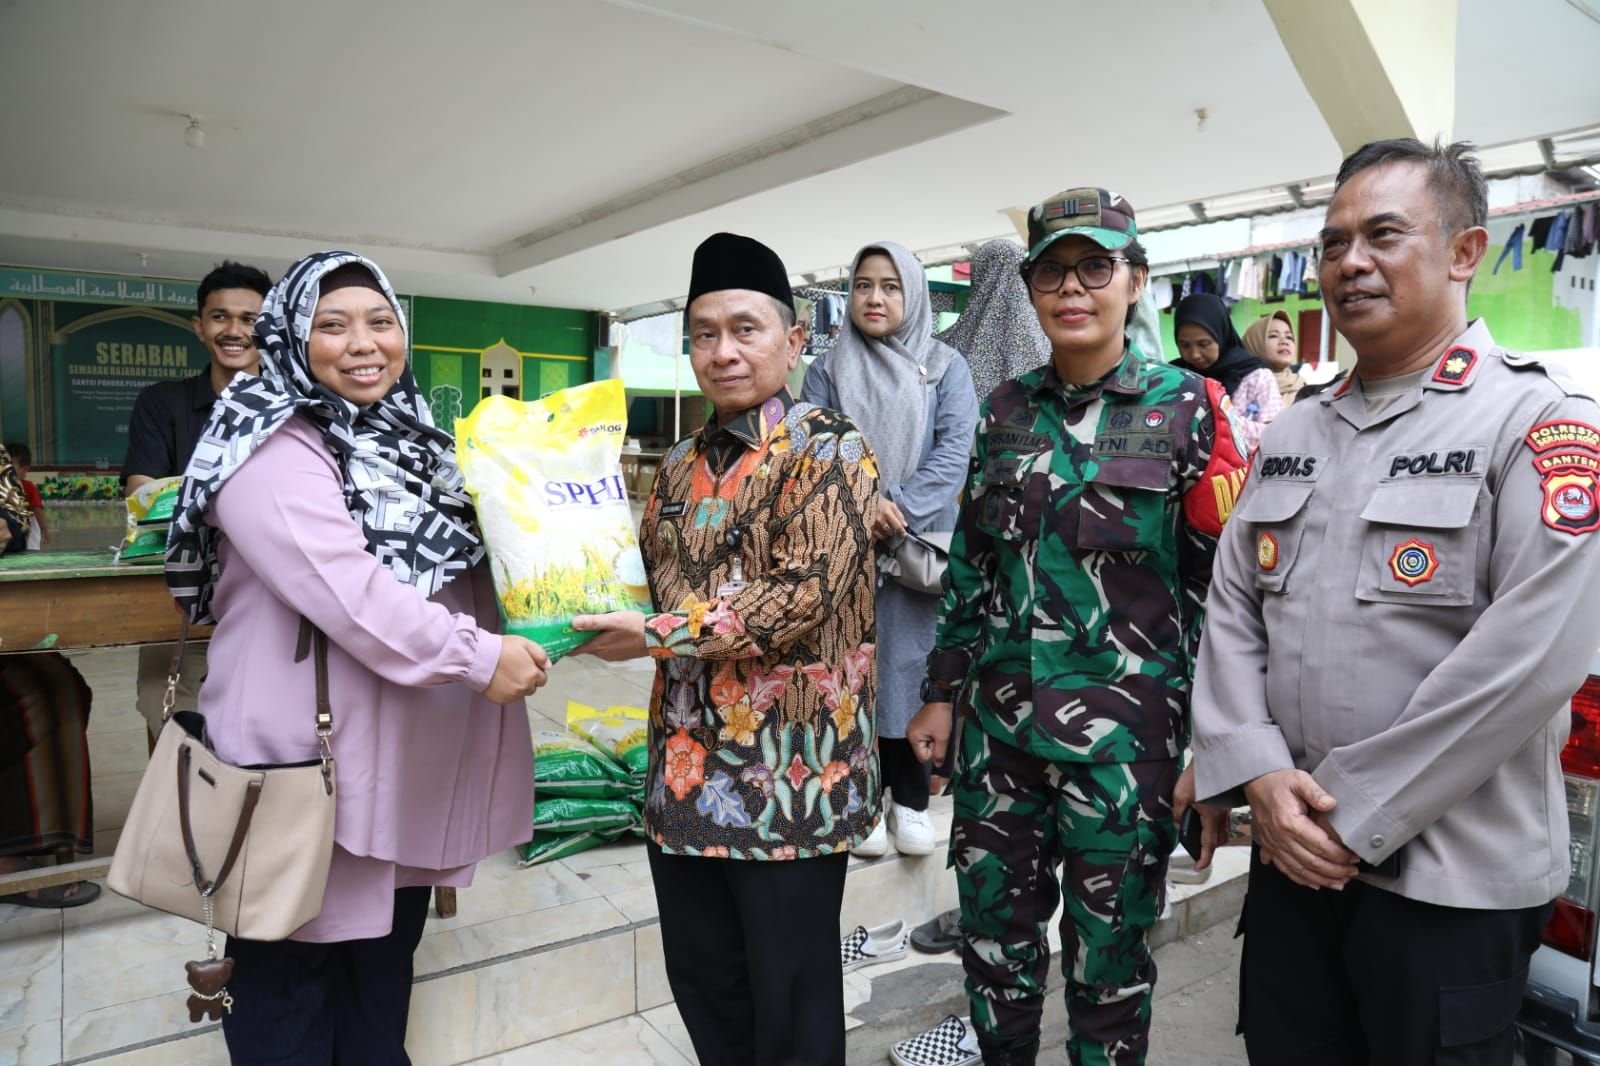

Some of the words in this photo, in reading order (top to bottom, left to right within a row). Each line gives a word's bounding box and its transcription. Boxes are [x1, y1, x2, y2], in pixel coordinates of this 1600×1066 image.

[96, 342, 188, 367] SERABAN
[1097, 436, 1128, 451] TNI
[1139, 438, 1171, 454] AD
[1390, 450, 1475, 478] POLRI
[1541, 455, 1599, 469] BANTEN
